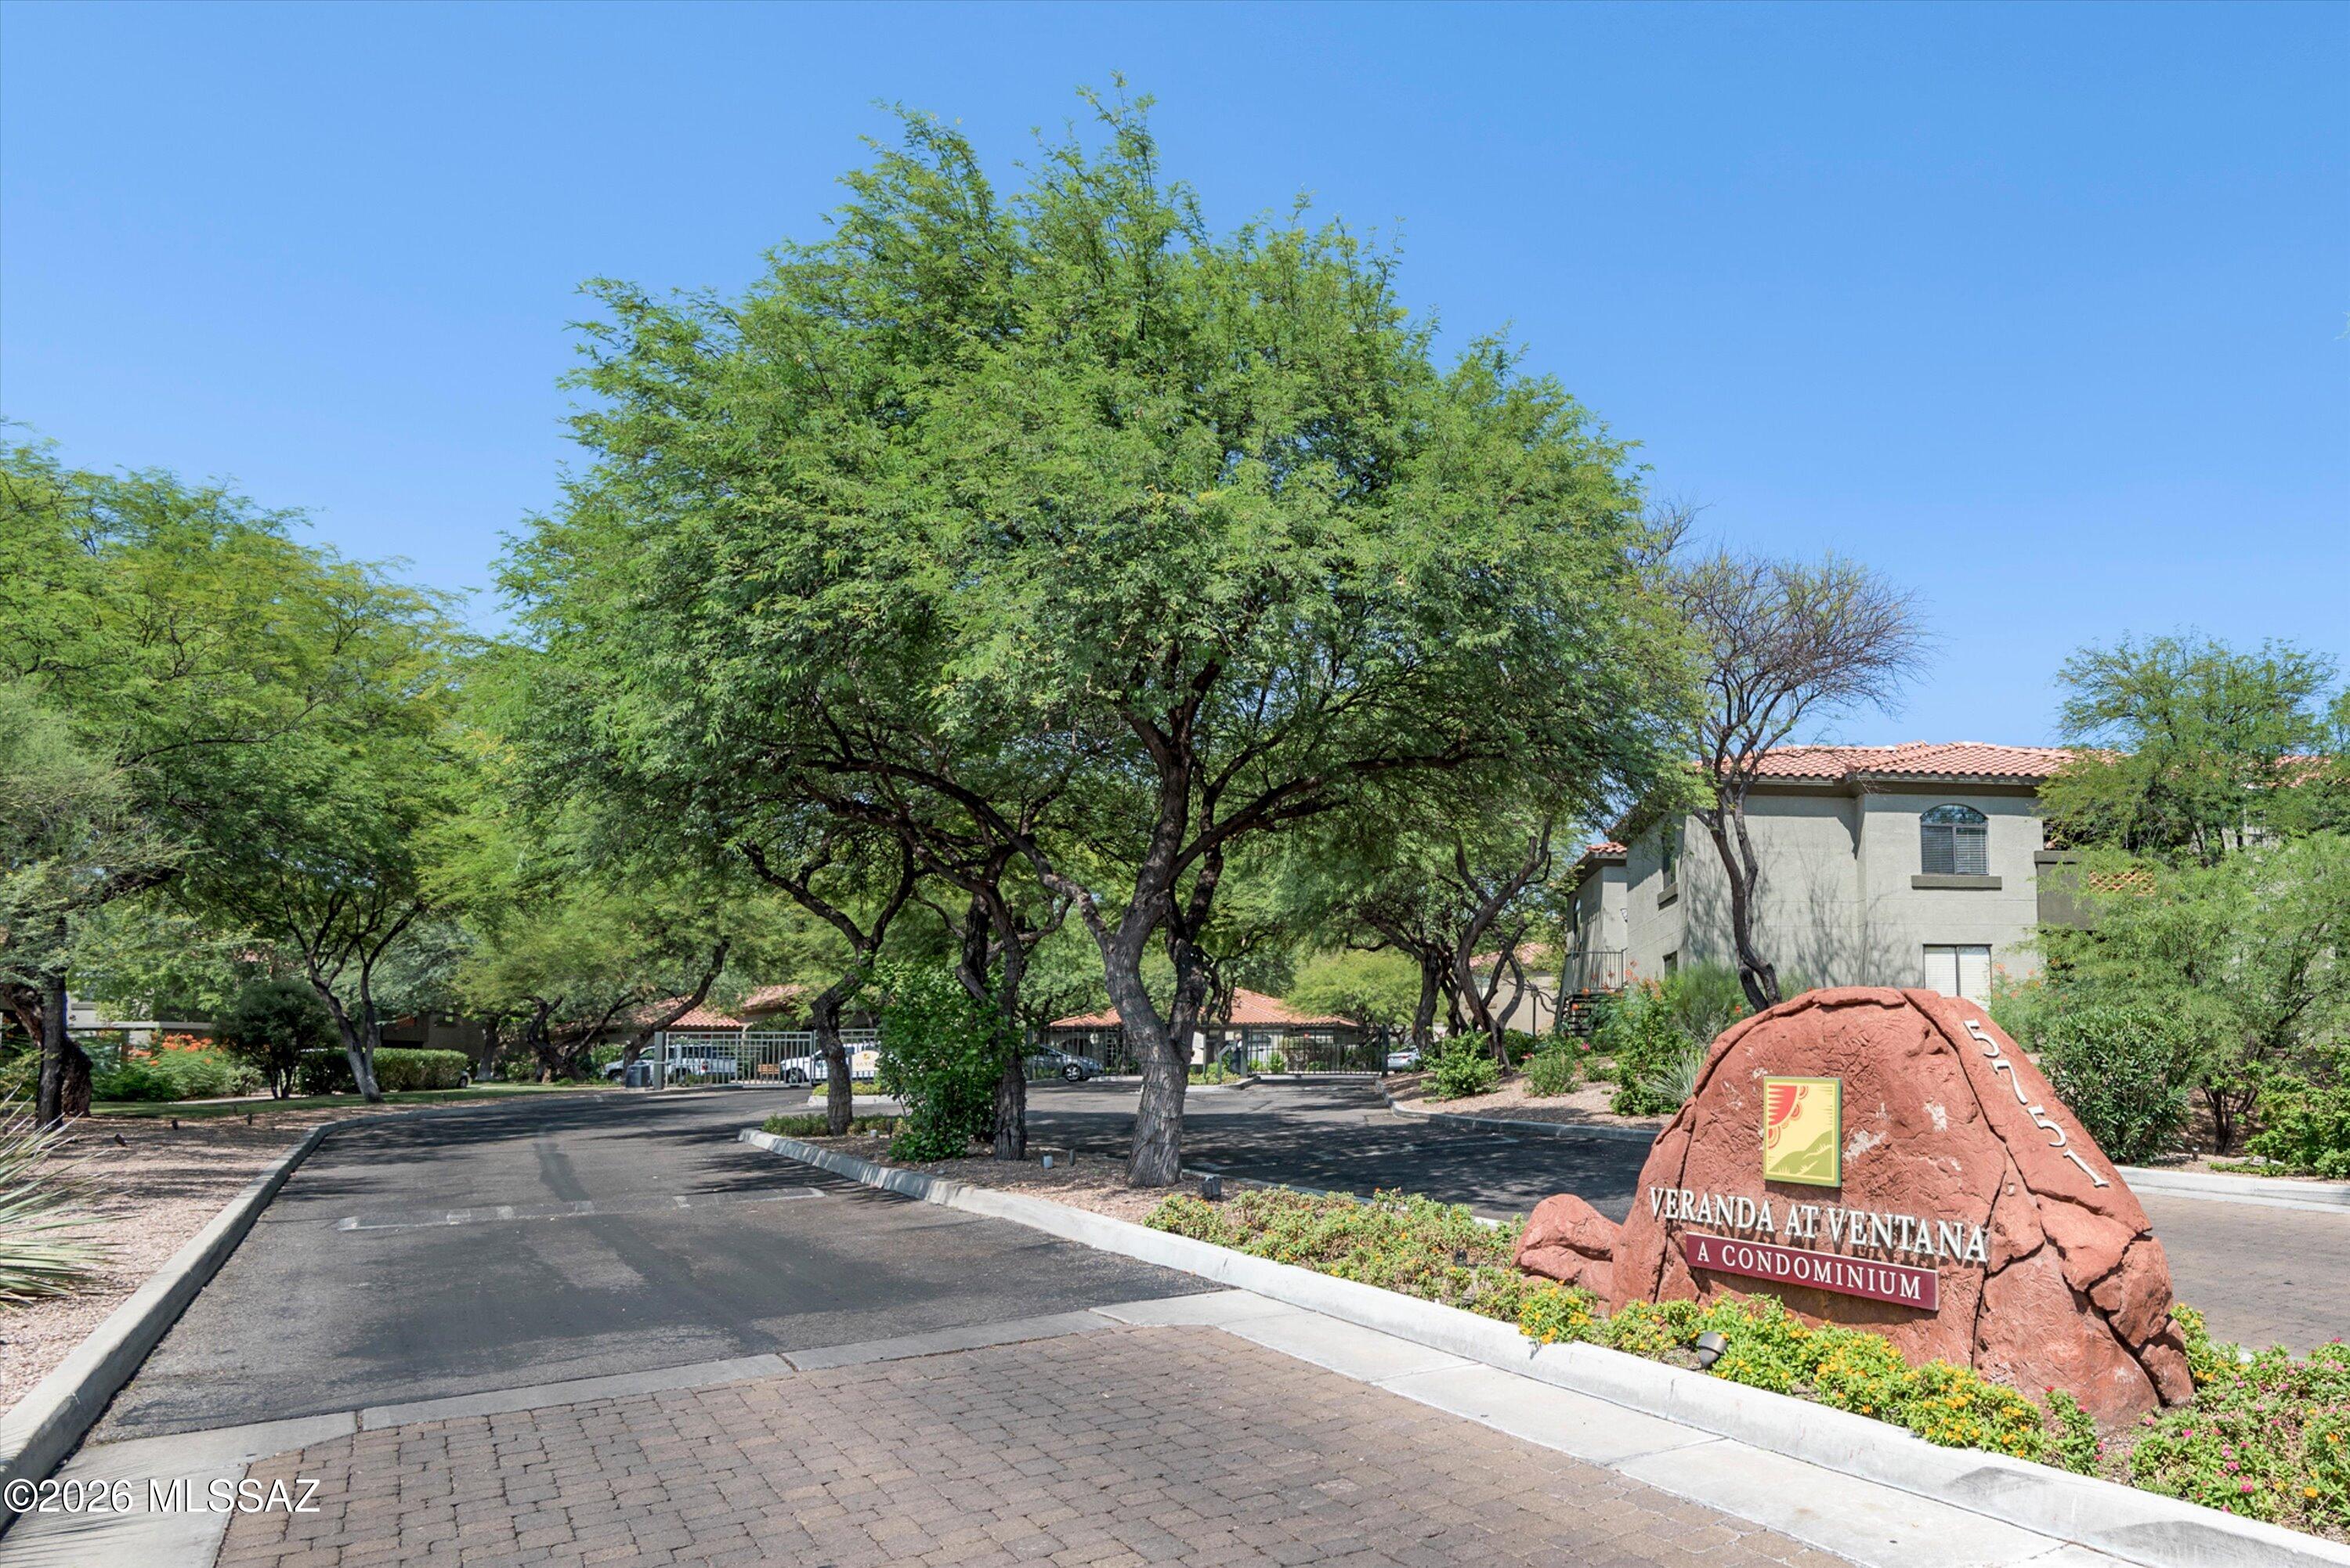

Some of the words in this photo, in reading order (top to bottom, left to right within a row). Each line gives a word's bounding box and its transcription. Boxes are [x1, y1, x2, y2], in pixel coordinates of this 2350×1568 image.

[1963, 1019, 2109, 1187] 5751
[1650, 1187, 1774, 1232] VERANDA
[1784, 1203, 1819, 1238] AT
[1828, 1208, 1988, 1263] VENTANA
[1697, 1241, 1710, 1263] A
[1722, 1245, 1922, 1300] CONDOMINIUM
